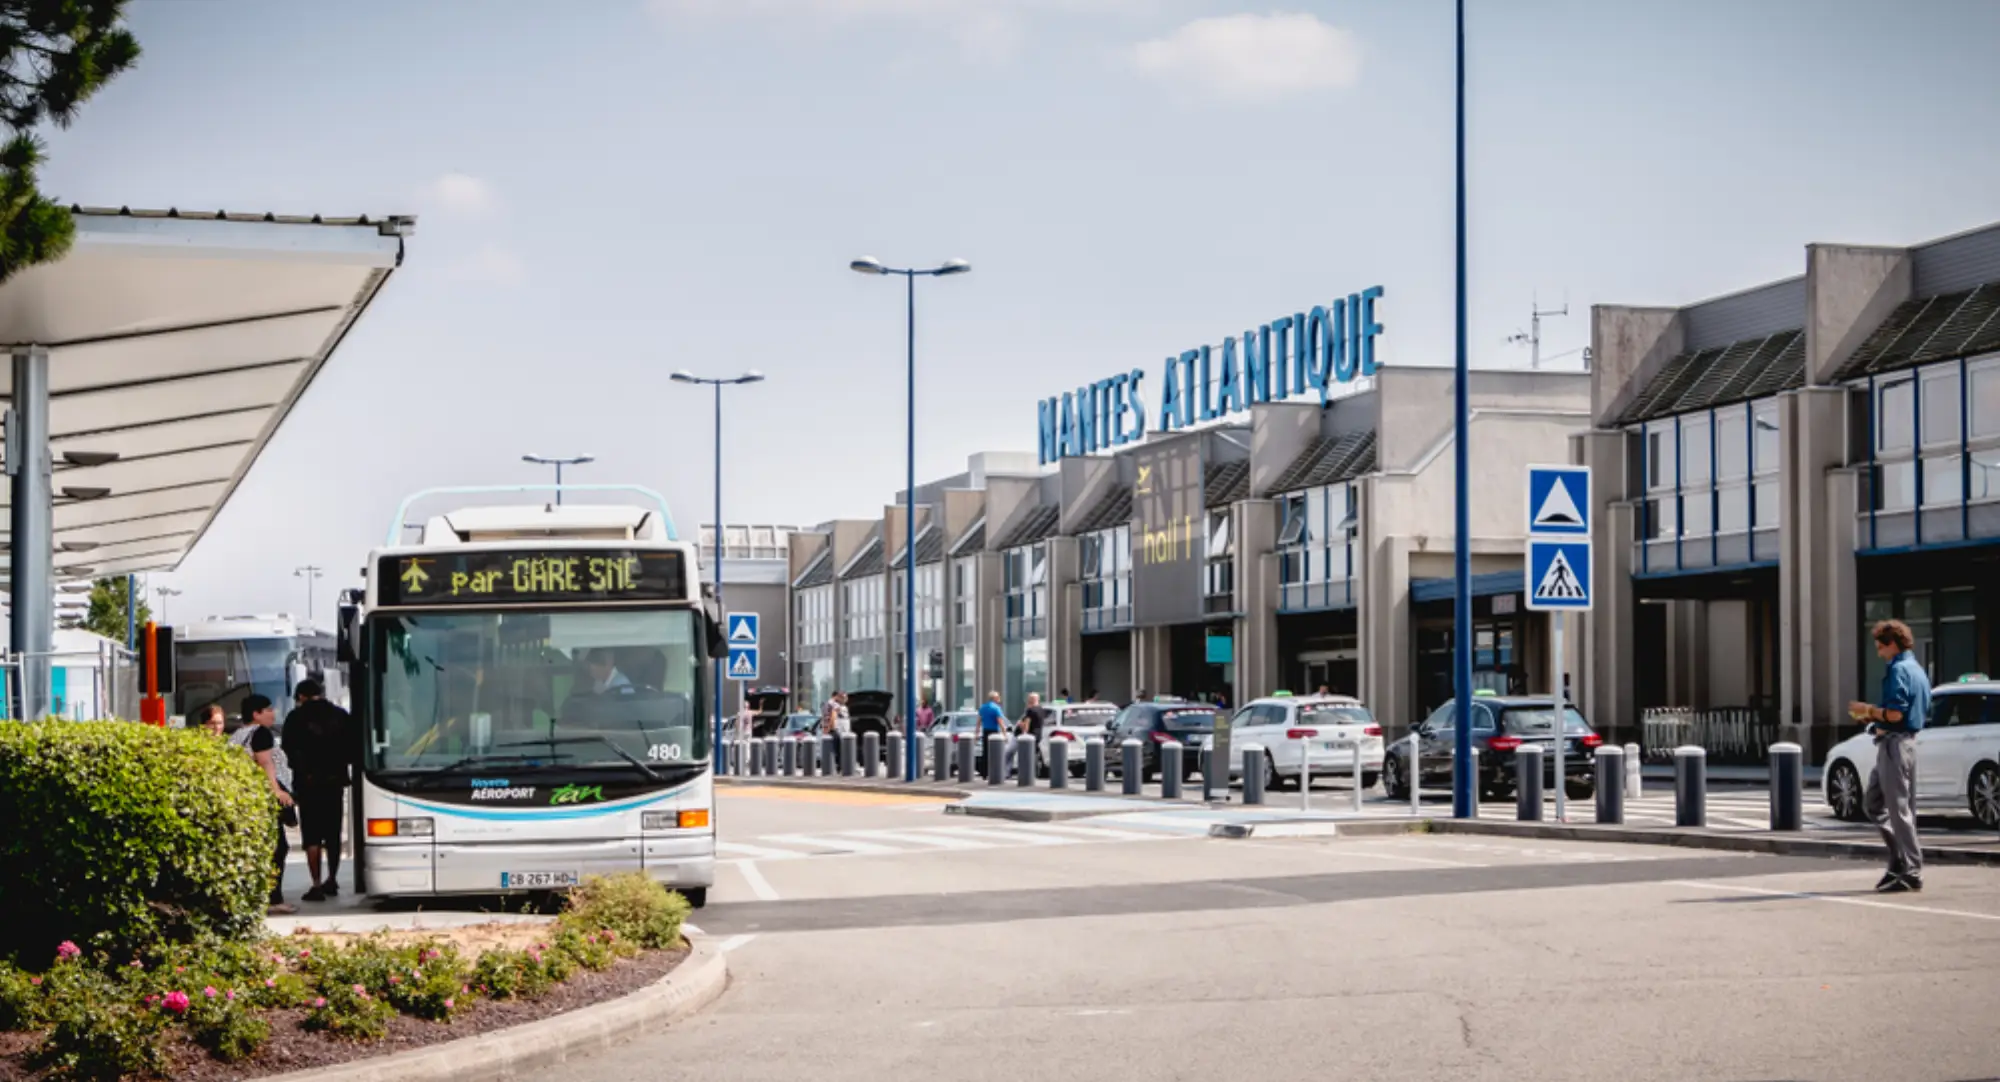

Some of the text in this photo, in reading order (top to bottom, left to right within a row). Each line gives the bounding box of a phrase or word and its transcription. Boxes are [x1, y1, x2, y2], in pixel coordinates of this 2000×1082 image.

[1038, 285, 1384, 465] NANTES ATLANTIQUE
[1143, 517, 1177, 565] hall
[451, 571, 503, 595] par
[513, 558, 581, 592] GARE
[647, 743, 681, 760] 480
[471, 787, 536, 800] AÉROPORT
